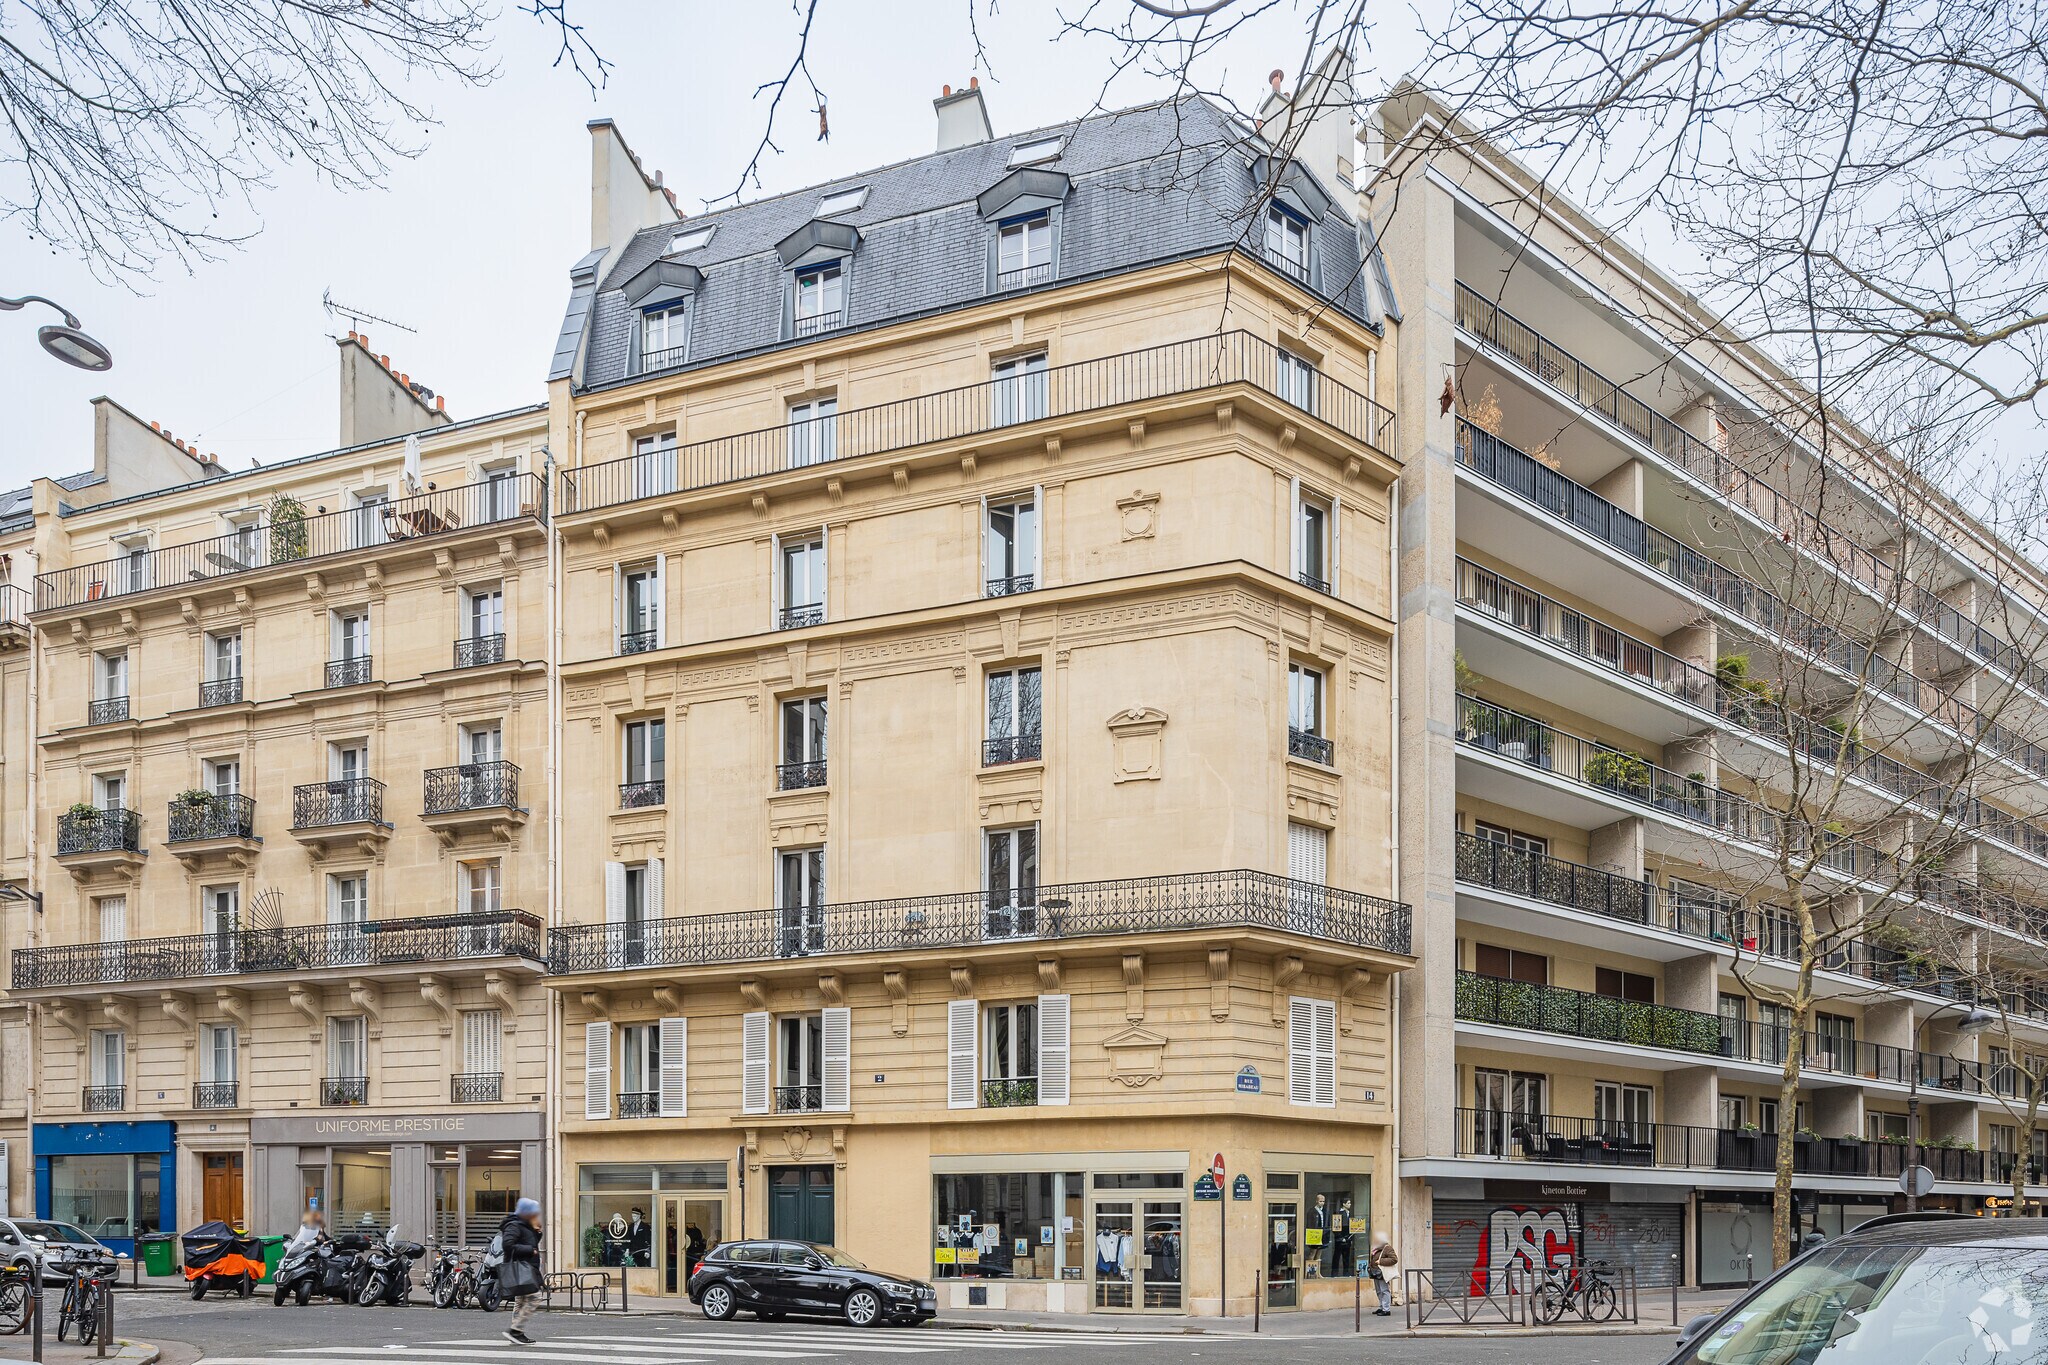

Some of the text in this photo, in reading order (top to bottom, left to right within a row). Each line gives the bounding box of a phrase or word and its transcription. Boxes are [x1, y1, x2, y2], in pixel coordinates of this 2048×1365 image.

[1366, 1091, 1373, 1100] 14
[315, 1117, 465, 1133] UNIFORME PRESTIGE
[1566, 1185, 1587, 1195] Bottier
[1730, 1259, 1752, 1270] OKT
